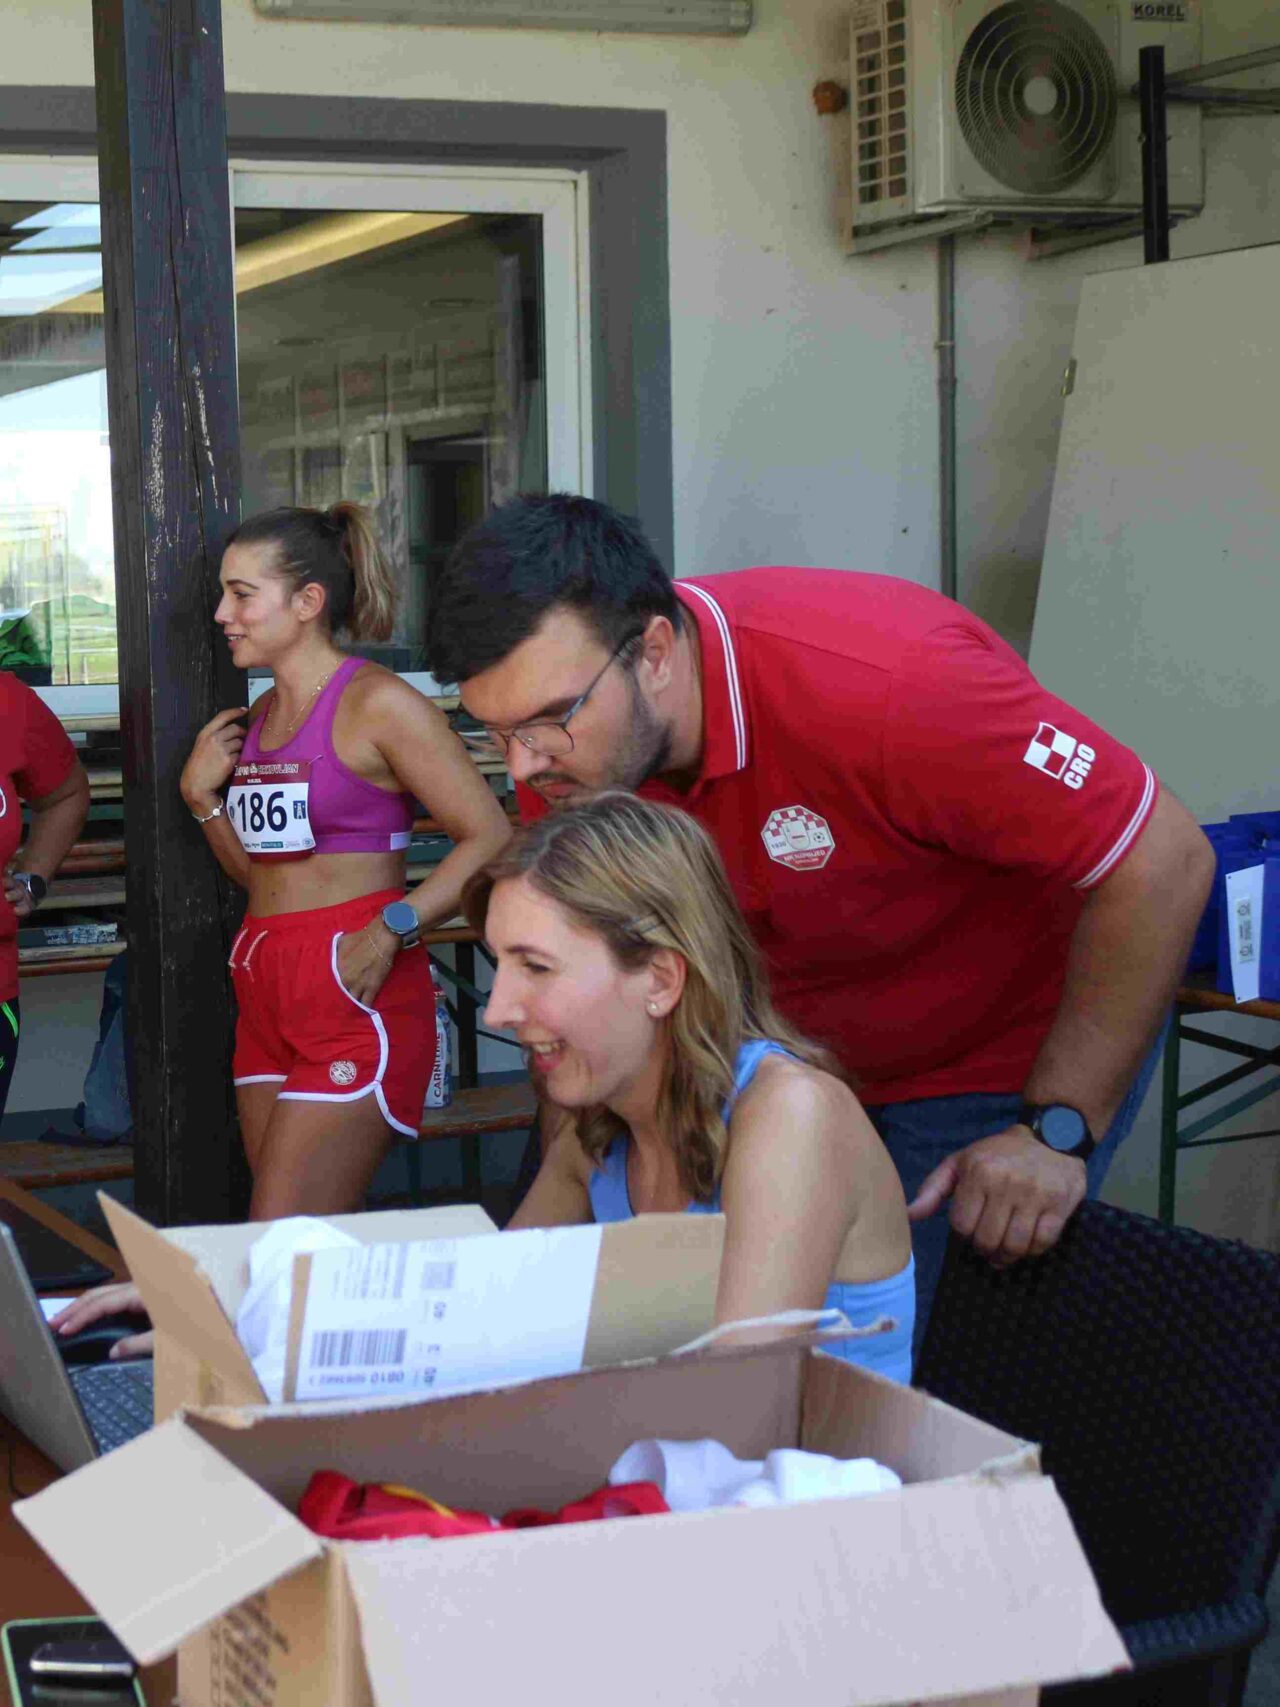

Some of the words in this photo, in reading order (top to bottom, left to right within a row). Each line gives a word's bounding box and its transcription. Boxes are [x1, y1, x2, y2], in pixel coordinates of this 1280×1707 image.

[1133, 3, 1184, 17] KOREL
[1063, 743, 1096, 790] CRO
[237, 791, 287, 833] 186
